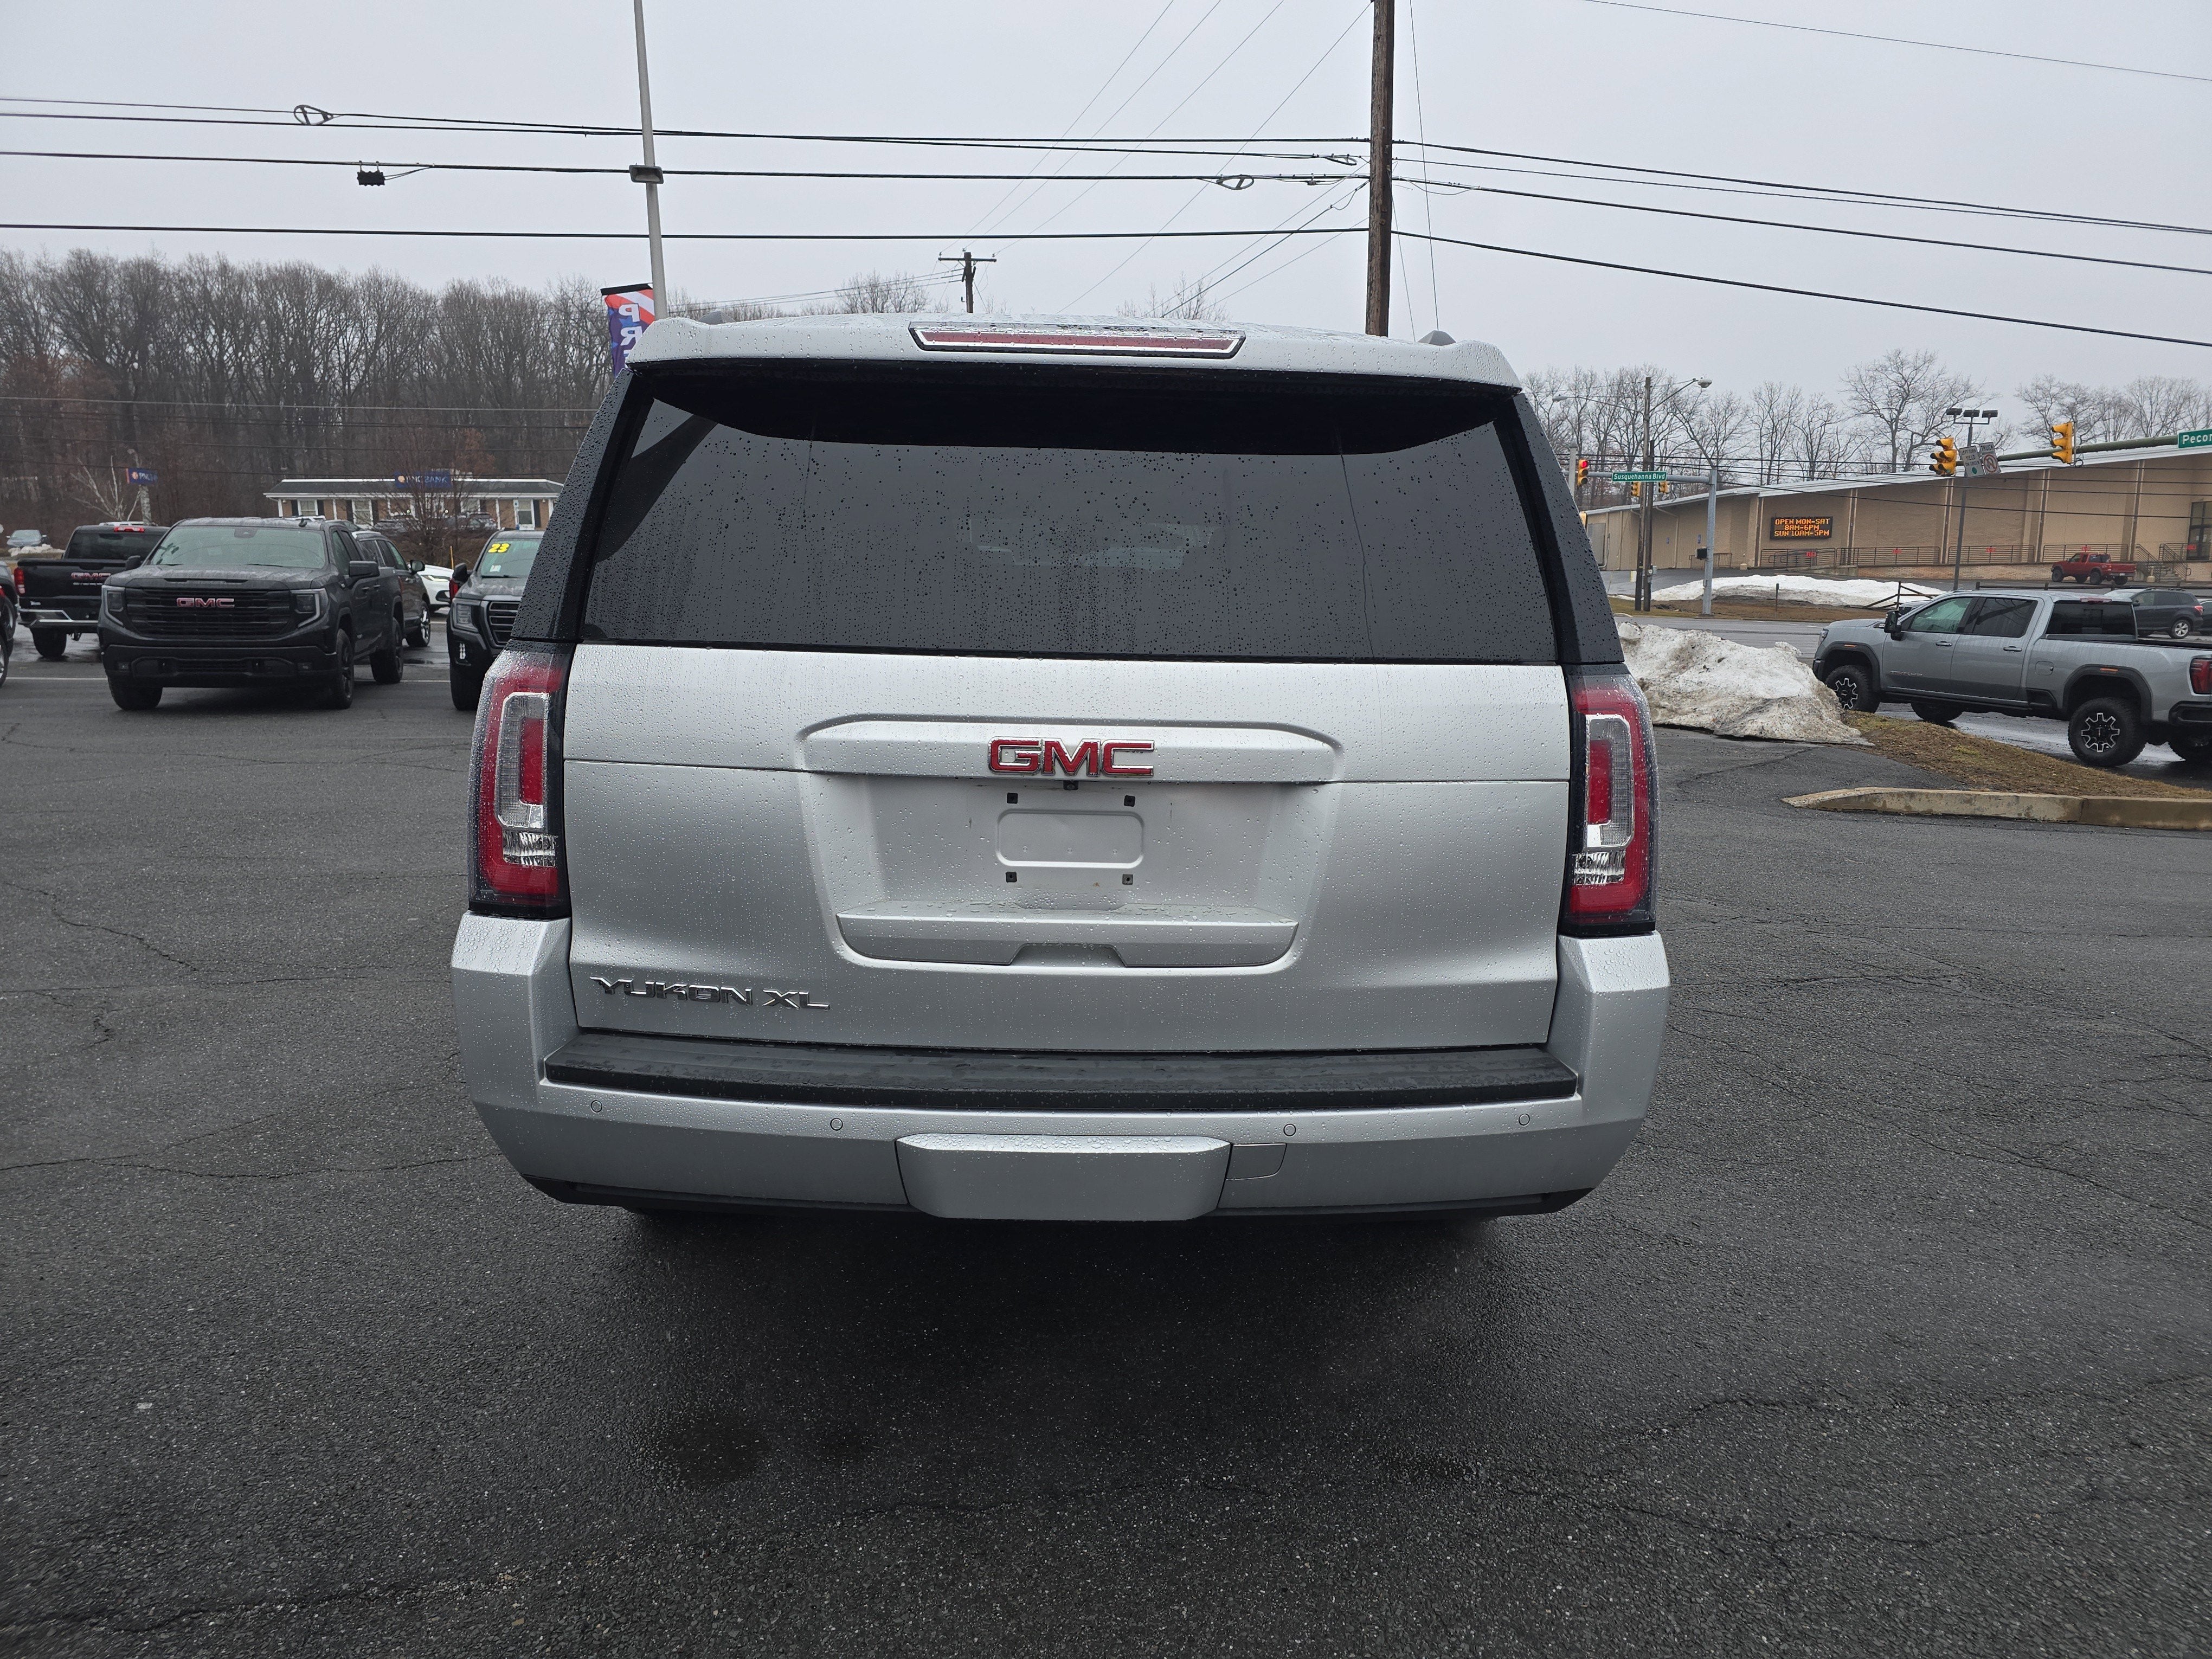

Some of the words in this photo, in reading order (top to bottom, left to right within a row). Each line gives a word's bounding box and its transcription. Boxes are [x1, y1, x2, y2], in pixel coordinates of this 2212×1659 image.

[488, 543, 510, 553] 23
[176, 597, 235, 607] GMC
[987, 736, 1155, 778] GMC
[589, 976, 753, 1006] YUKON
[762, 989, 830, 1011] XL
